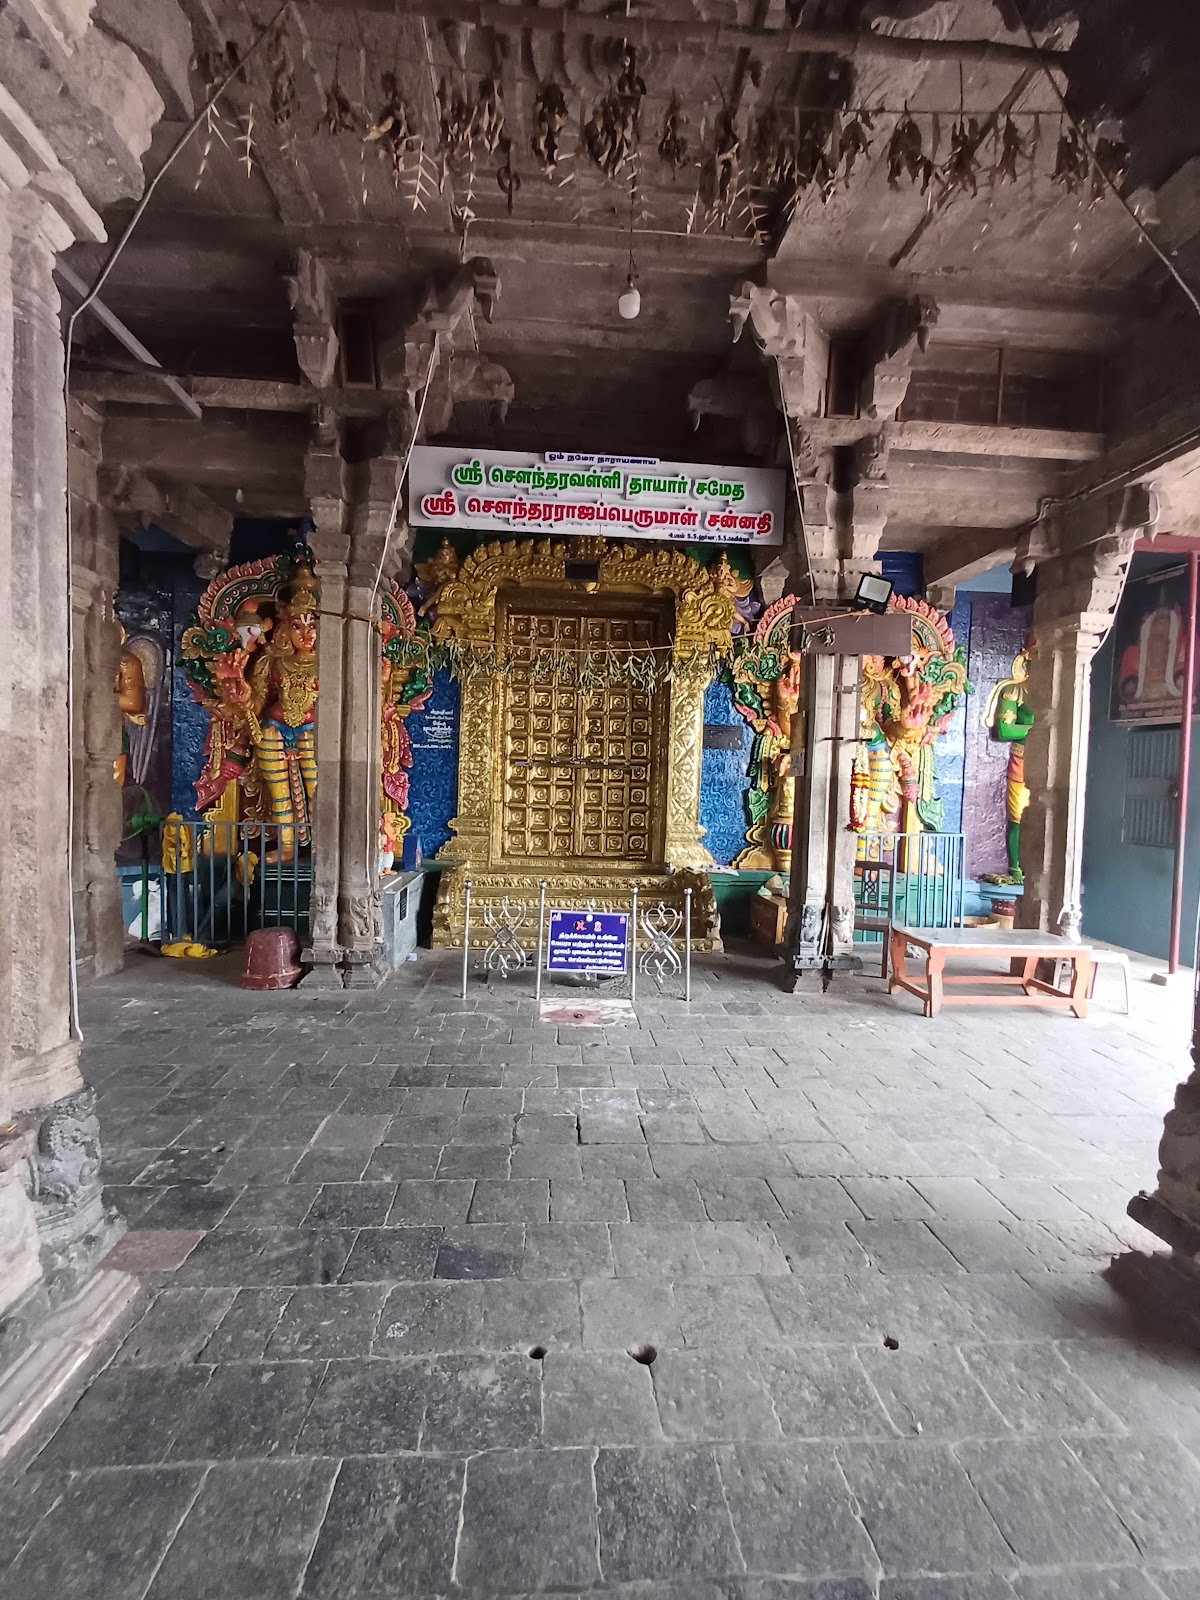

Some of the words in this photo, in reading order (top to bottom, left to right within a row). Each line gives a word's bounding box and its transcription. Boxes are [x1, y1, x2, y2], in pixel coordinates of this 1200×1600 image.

[454, 460, 483, 485] ஸ்ரீ
[491, 466, 621, 491] சௌந்தரவள்ளி
[629, 475, 688, 495] தாயார்
[696, 480, 745, 501] சமேத
[423, 491, 456, 516] ஸ்ரீ
[708, 509, 772, 535] சன்னதி
